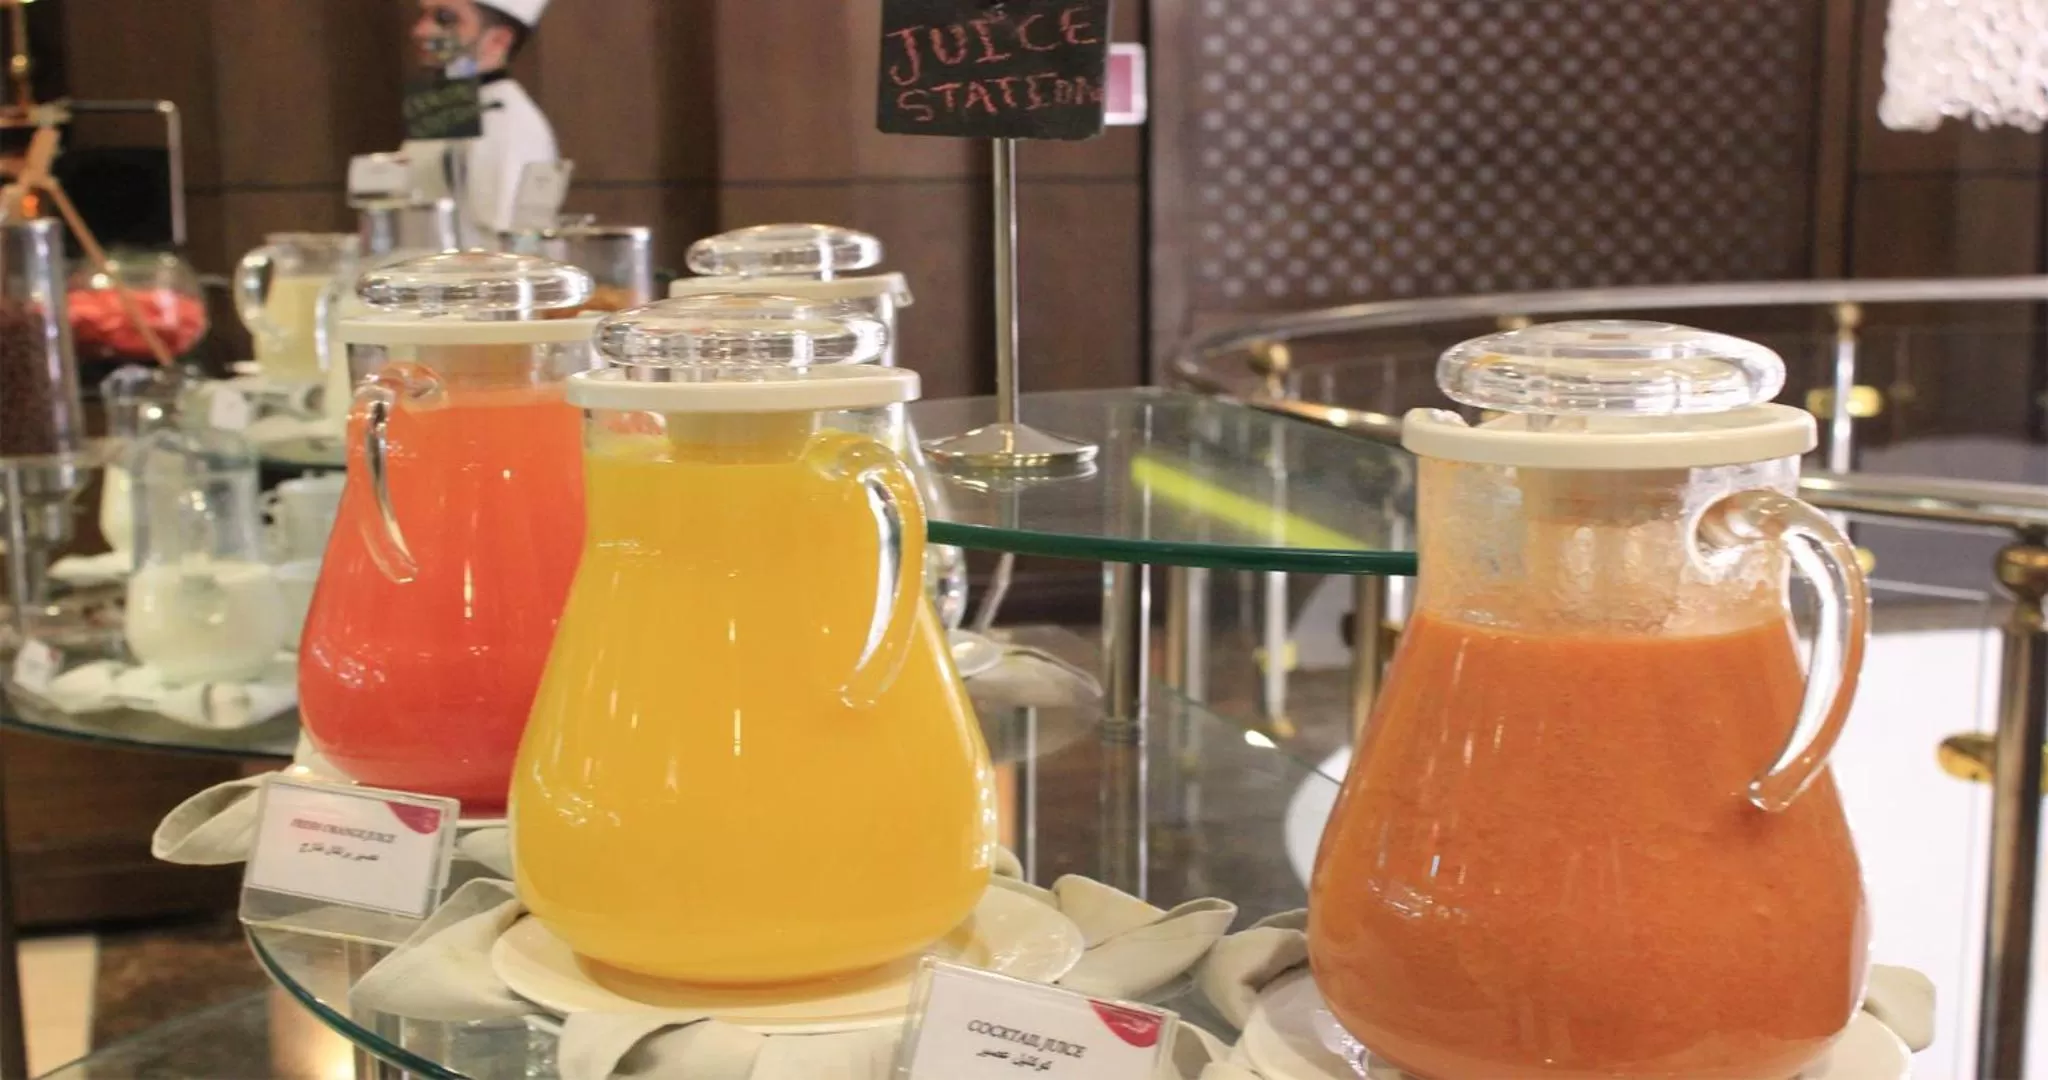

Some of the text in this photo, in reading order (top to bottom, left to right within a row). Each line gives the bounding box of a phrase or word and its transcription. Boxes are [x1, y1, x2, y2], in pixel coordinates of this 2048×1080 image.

[886, 5, 1097, 85] JUICE
[967, 1019, 1087, 1058] COCKTAIL JUICE
